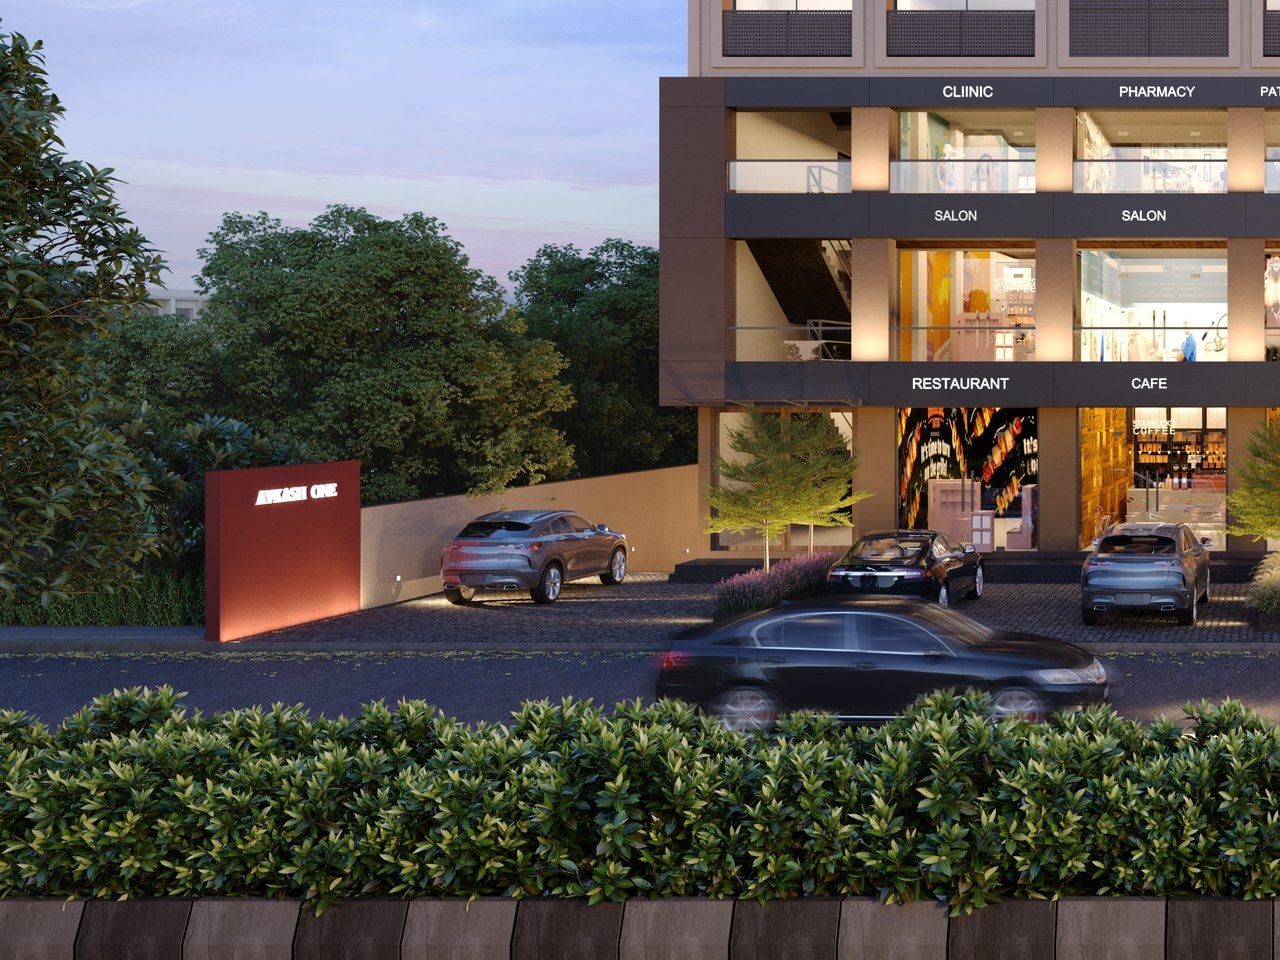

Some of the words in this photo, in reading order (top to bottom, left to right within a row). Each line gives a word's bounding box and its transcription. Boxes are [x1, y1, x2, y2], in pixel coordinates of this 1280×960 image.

[942, 85, 994, 98] CLIINIC
[1119, 85, 1196, 98] PHARMACY
[934, 209, 977, 222] SALON
[1121, 209, 1167, 222] SALON
[912, 377, 1010, 390] RESTAURANT
[1131, 377, 1168, 390] CAFE
[1132, 427, 1176, 435] COFFEE
[255, 485, 308, 506] AVKASH
[310, 483, 338, 499] ONE
